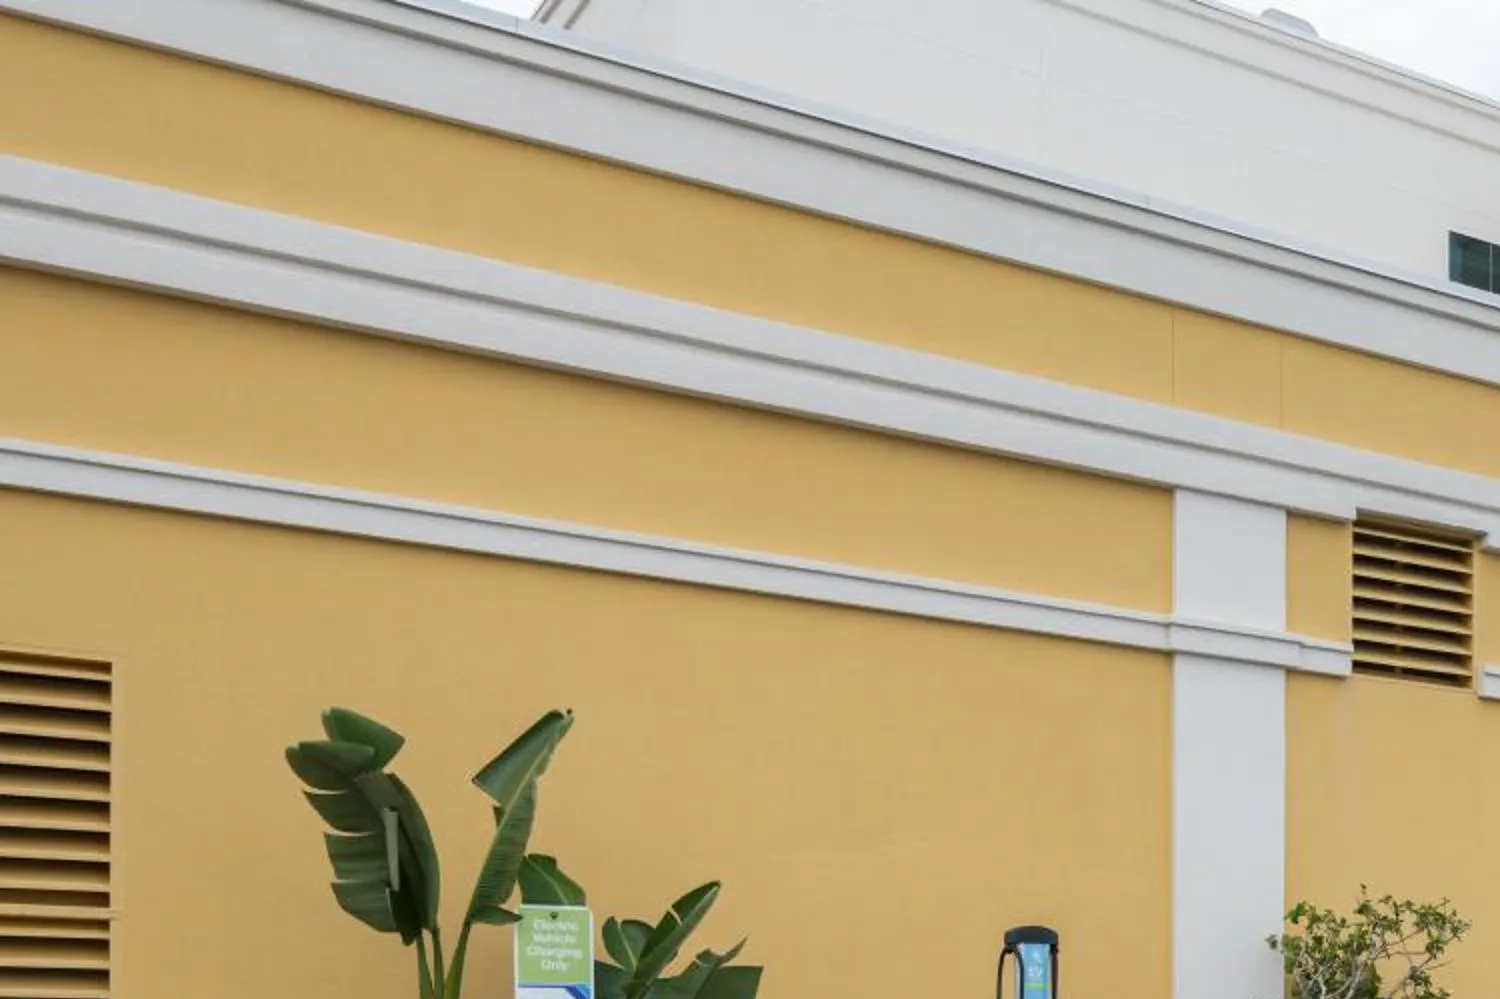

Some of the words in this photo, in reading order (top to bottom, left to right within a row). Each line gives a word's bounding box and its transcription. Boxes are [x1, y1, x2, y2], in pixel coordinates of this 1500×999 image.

[533, 919, 579, 931] Electric
[533, 932, 577, 944] Vehicle
[527, 945, 582, 959] Charging
[540, 959, 569, 972] Only
